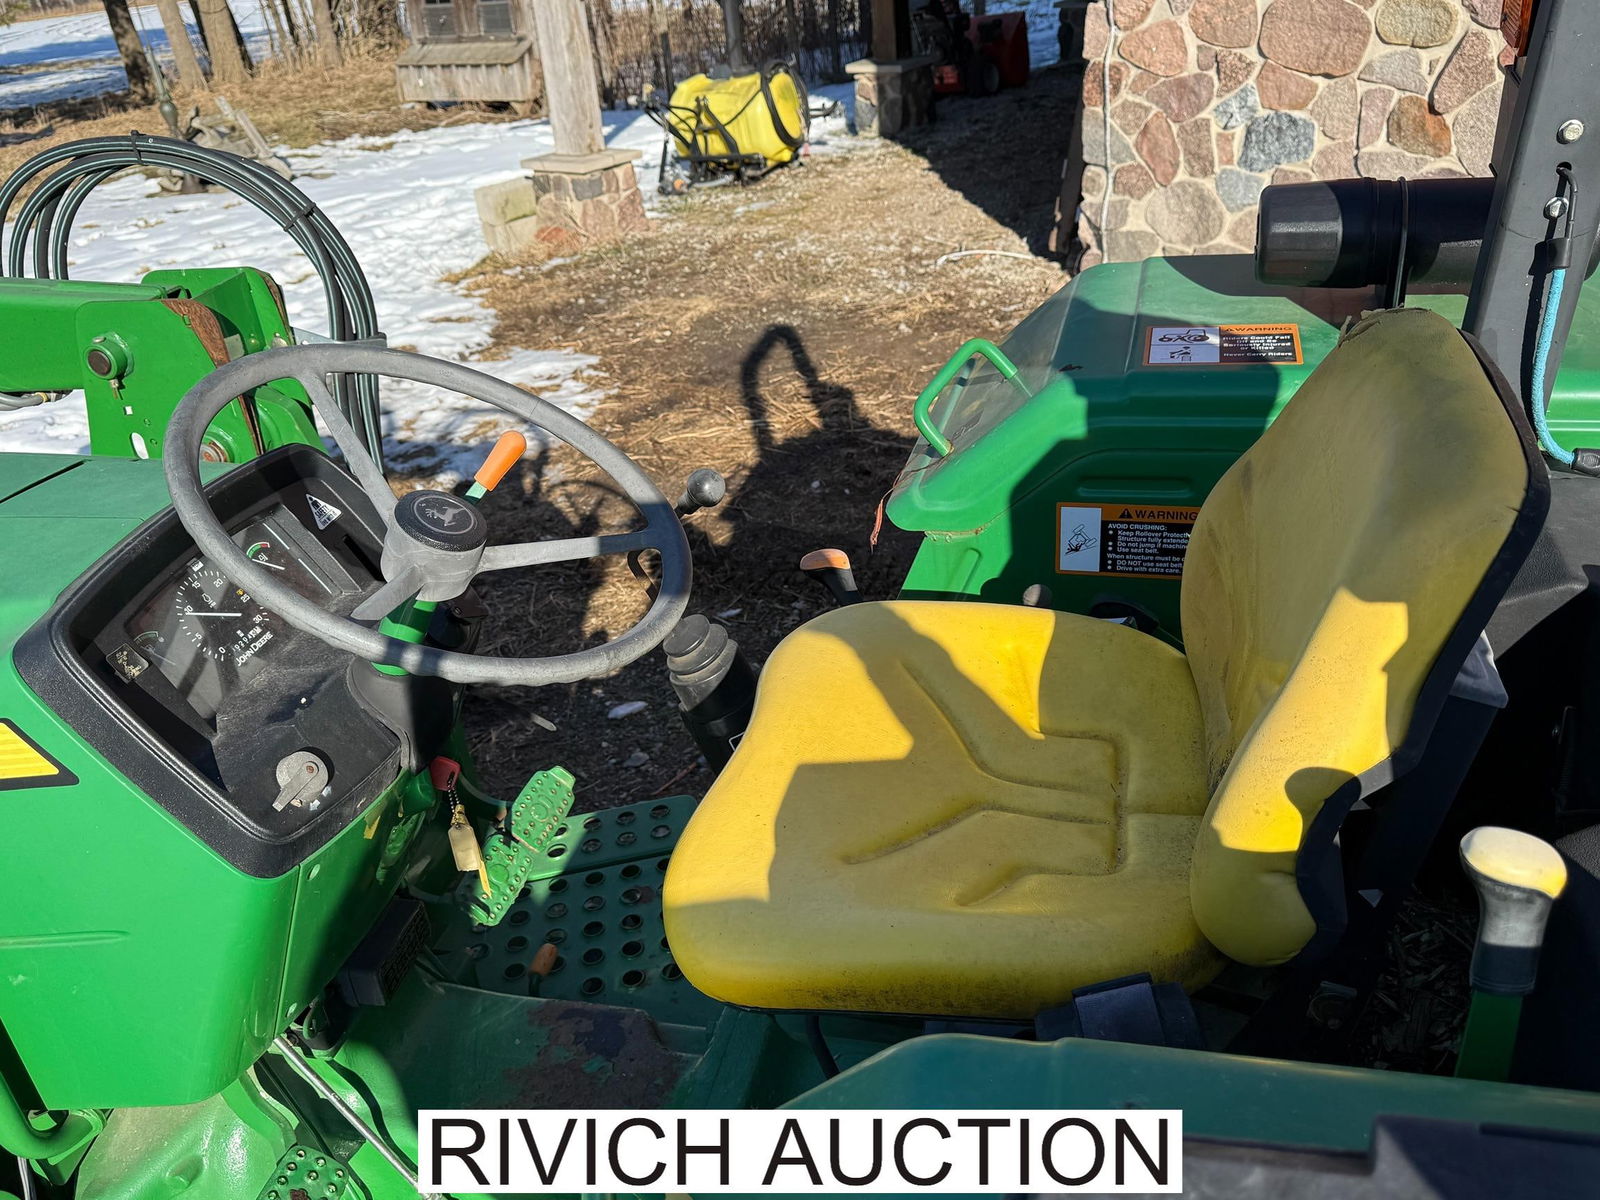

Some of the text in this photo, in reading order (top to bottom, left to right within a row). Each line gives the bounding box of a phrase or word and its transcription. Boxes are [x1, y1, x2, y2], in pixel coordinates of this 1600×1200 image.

[1135, 509, 1198, 521] WARNING
[1117, 530, 1135, 538] Keep
[191, 580, 201, 589] 15
[213, 578, 224, 588] 20
[240, 593, 250, 603] 25
[183, 604, 194, 615] 10
[252, 614, 263, 624] 30
[195, 632, 203, 640] 5
[218, 646, 226, 654] 0
[235, 647, 254, 666] JOHN
[250, 631, 274, 652] DEERE
